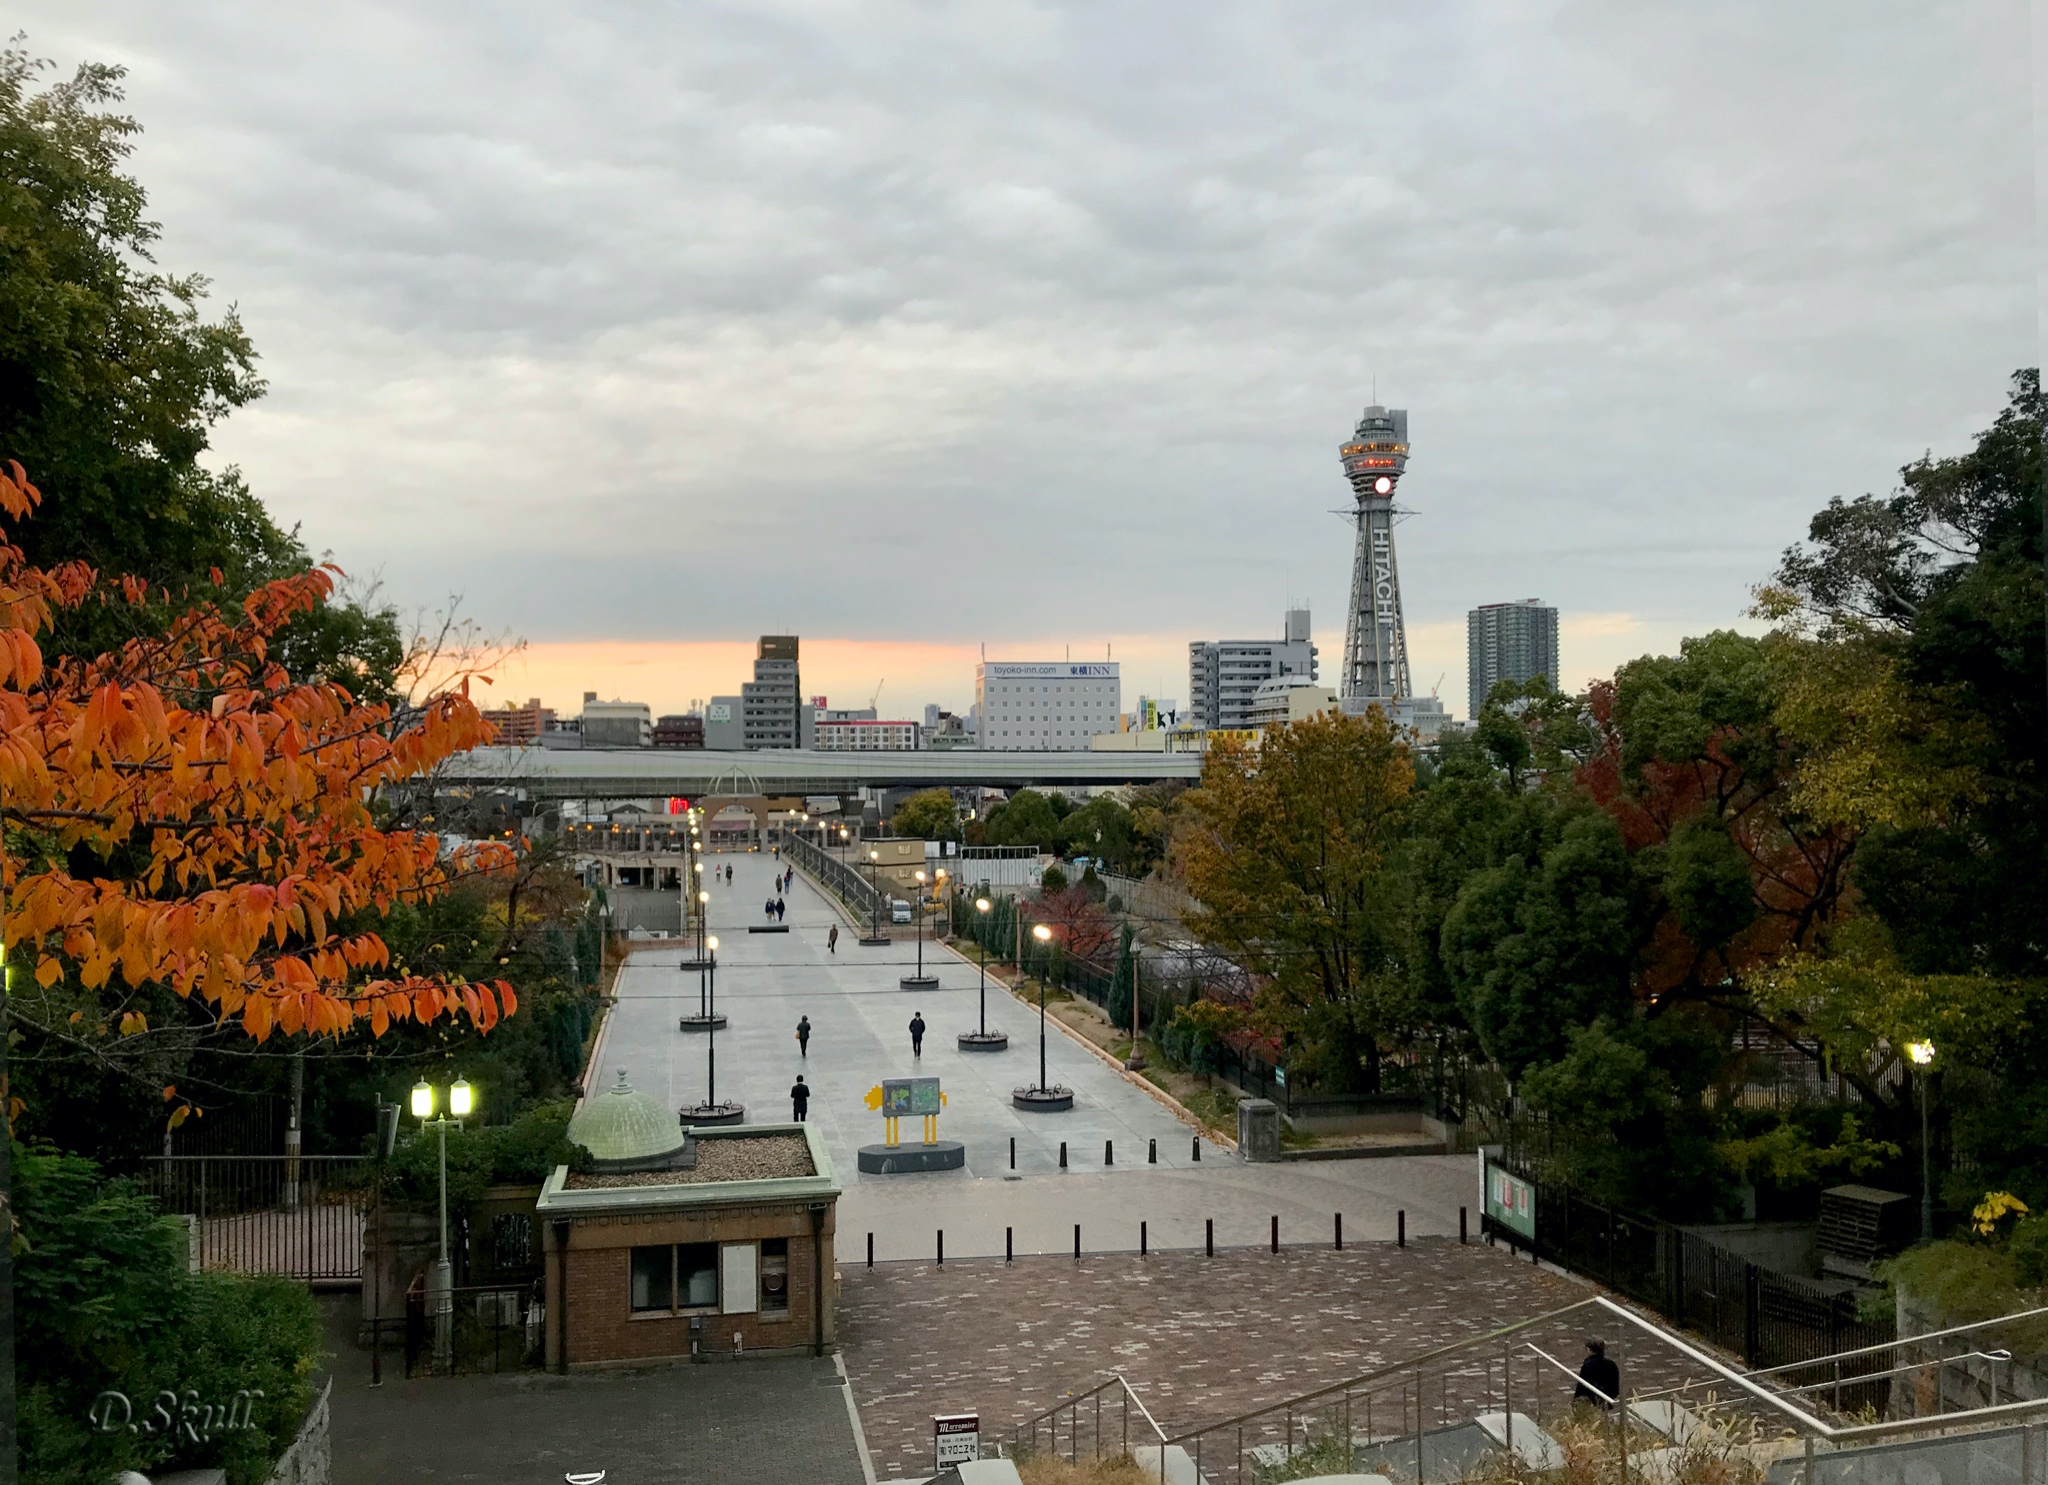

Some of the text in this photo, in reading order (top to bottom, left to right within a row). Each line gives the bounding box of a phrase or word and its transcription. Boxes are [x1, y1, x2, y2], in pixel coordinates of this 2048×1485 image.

[1374, 529, 1393, 623] HITACHI
[994, 666, 1056, 675] toyoko-inn.com
[1070, 666, 1110, 675] 東横INN
